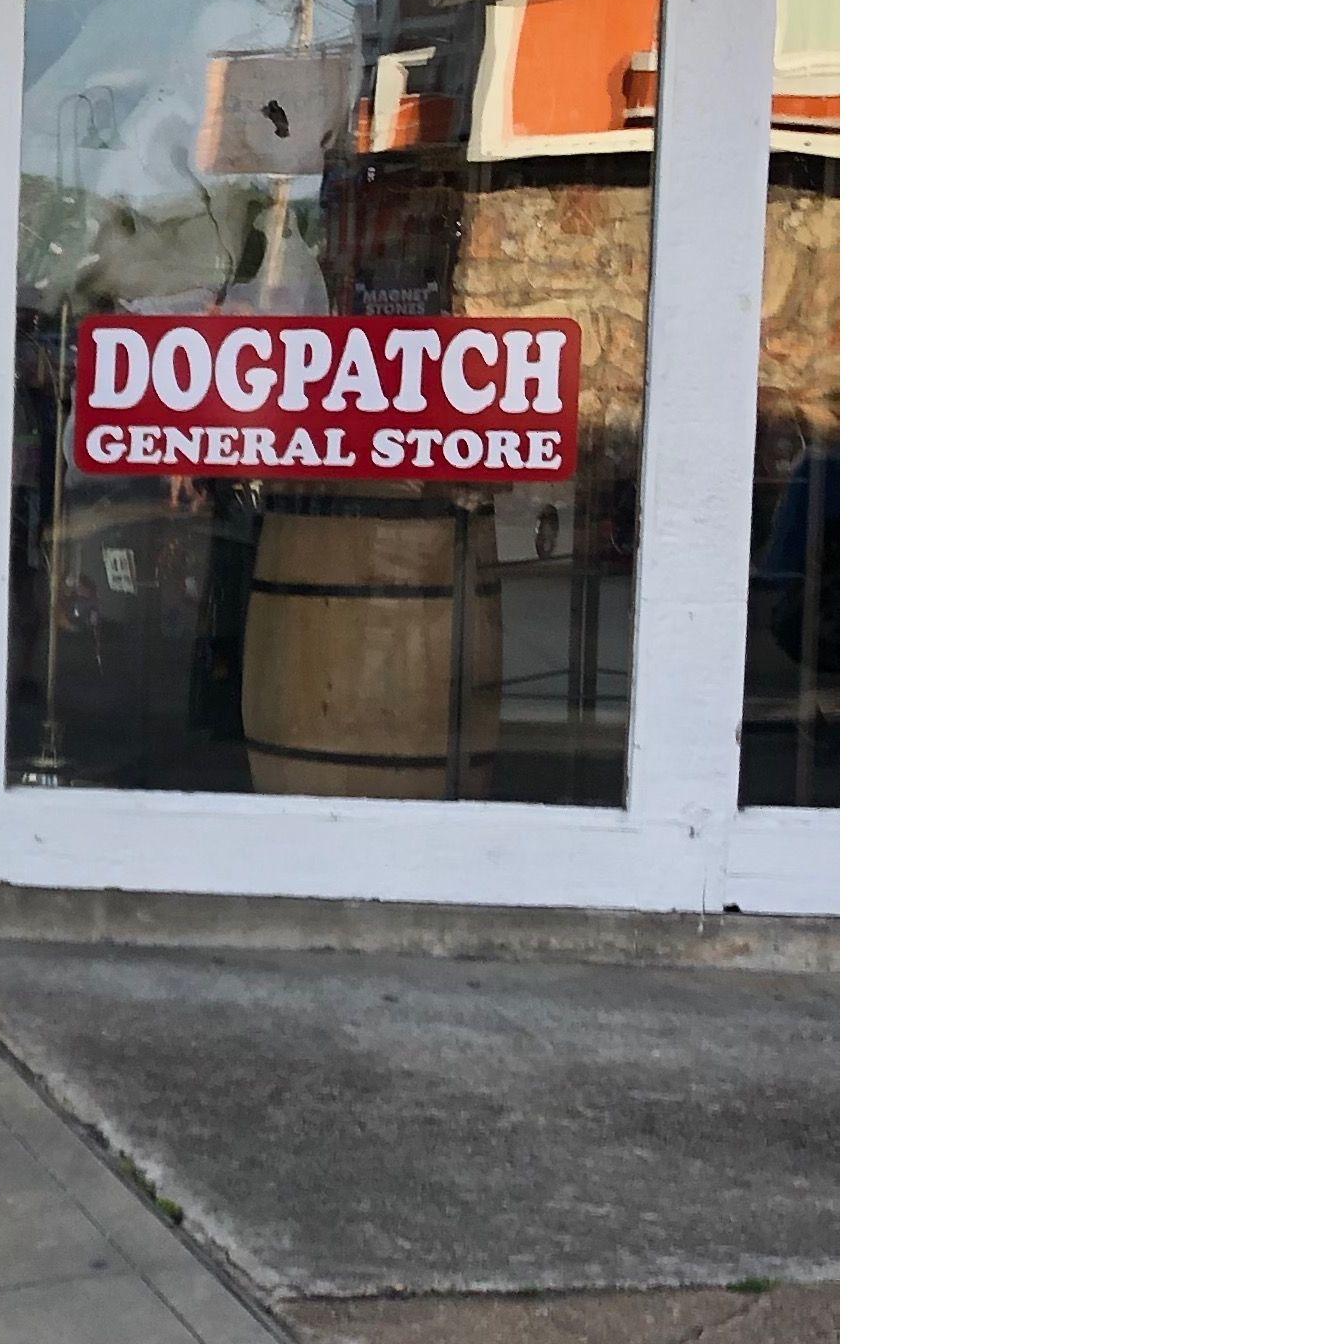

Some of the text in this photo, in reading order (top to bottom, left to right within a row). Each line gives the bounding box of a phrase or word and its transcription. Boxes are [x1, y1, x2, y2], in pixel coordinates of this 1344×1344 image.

[88, 325, 567, 415] DOGPATCH
[85, 424, 563, 470] GENERAL STORE
